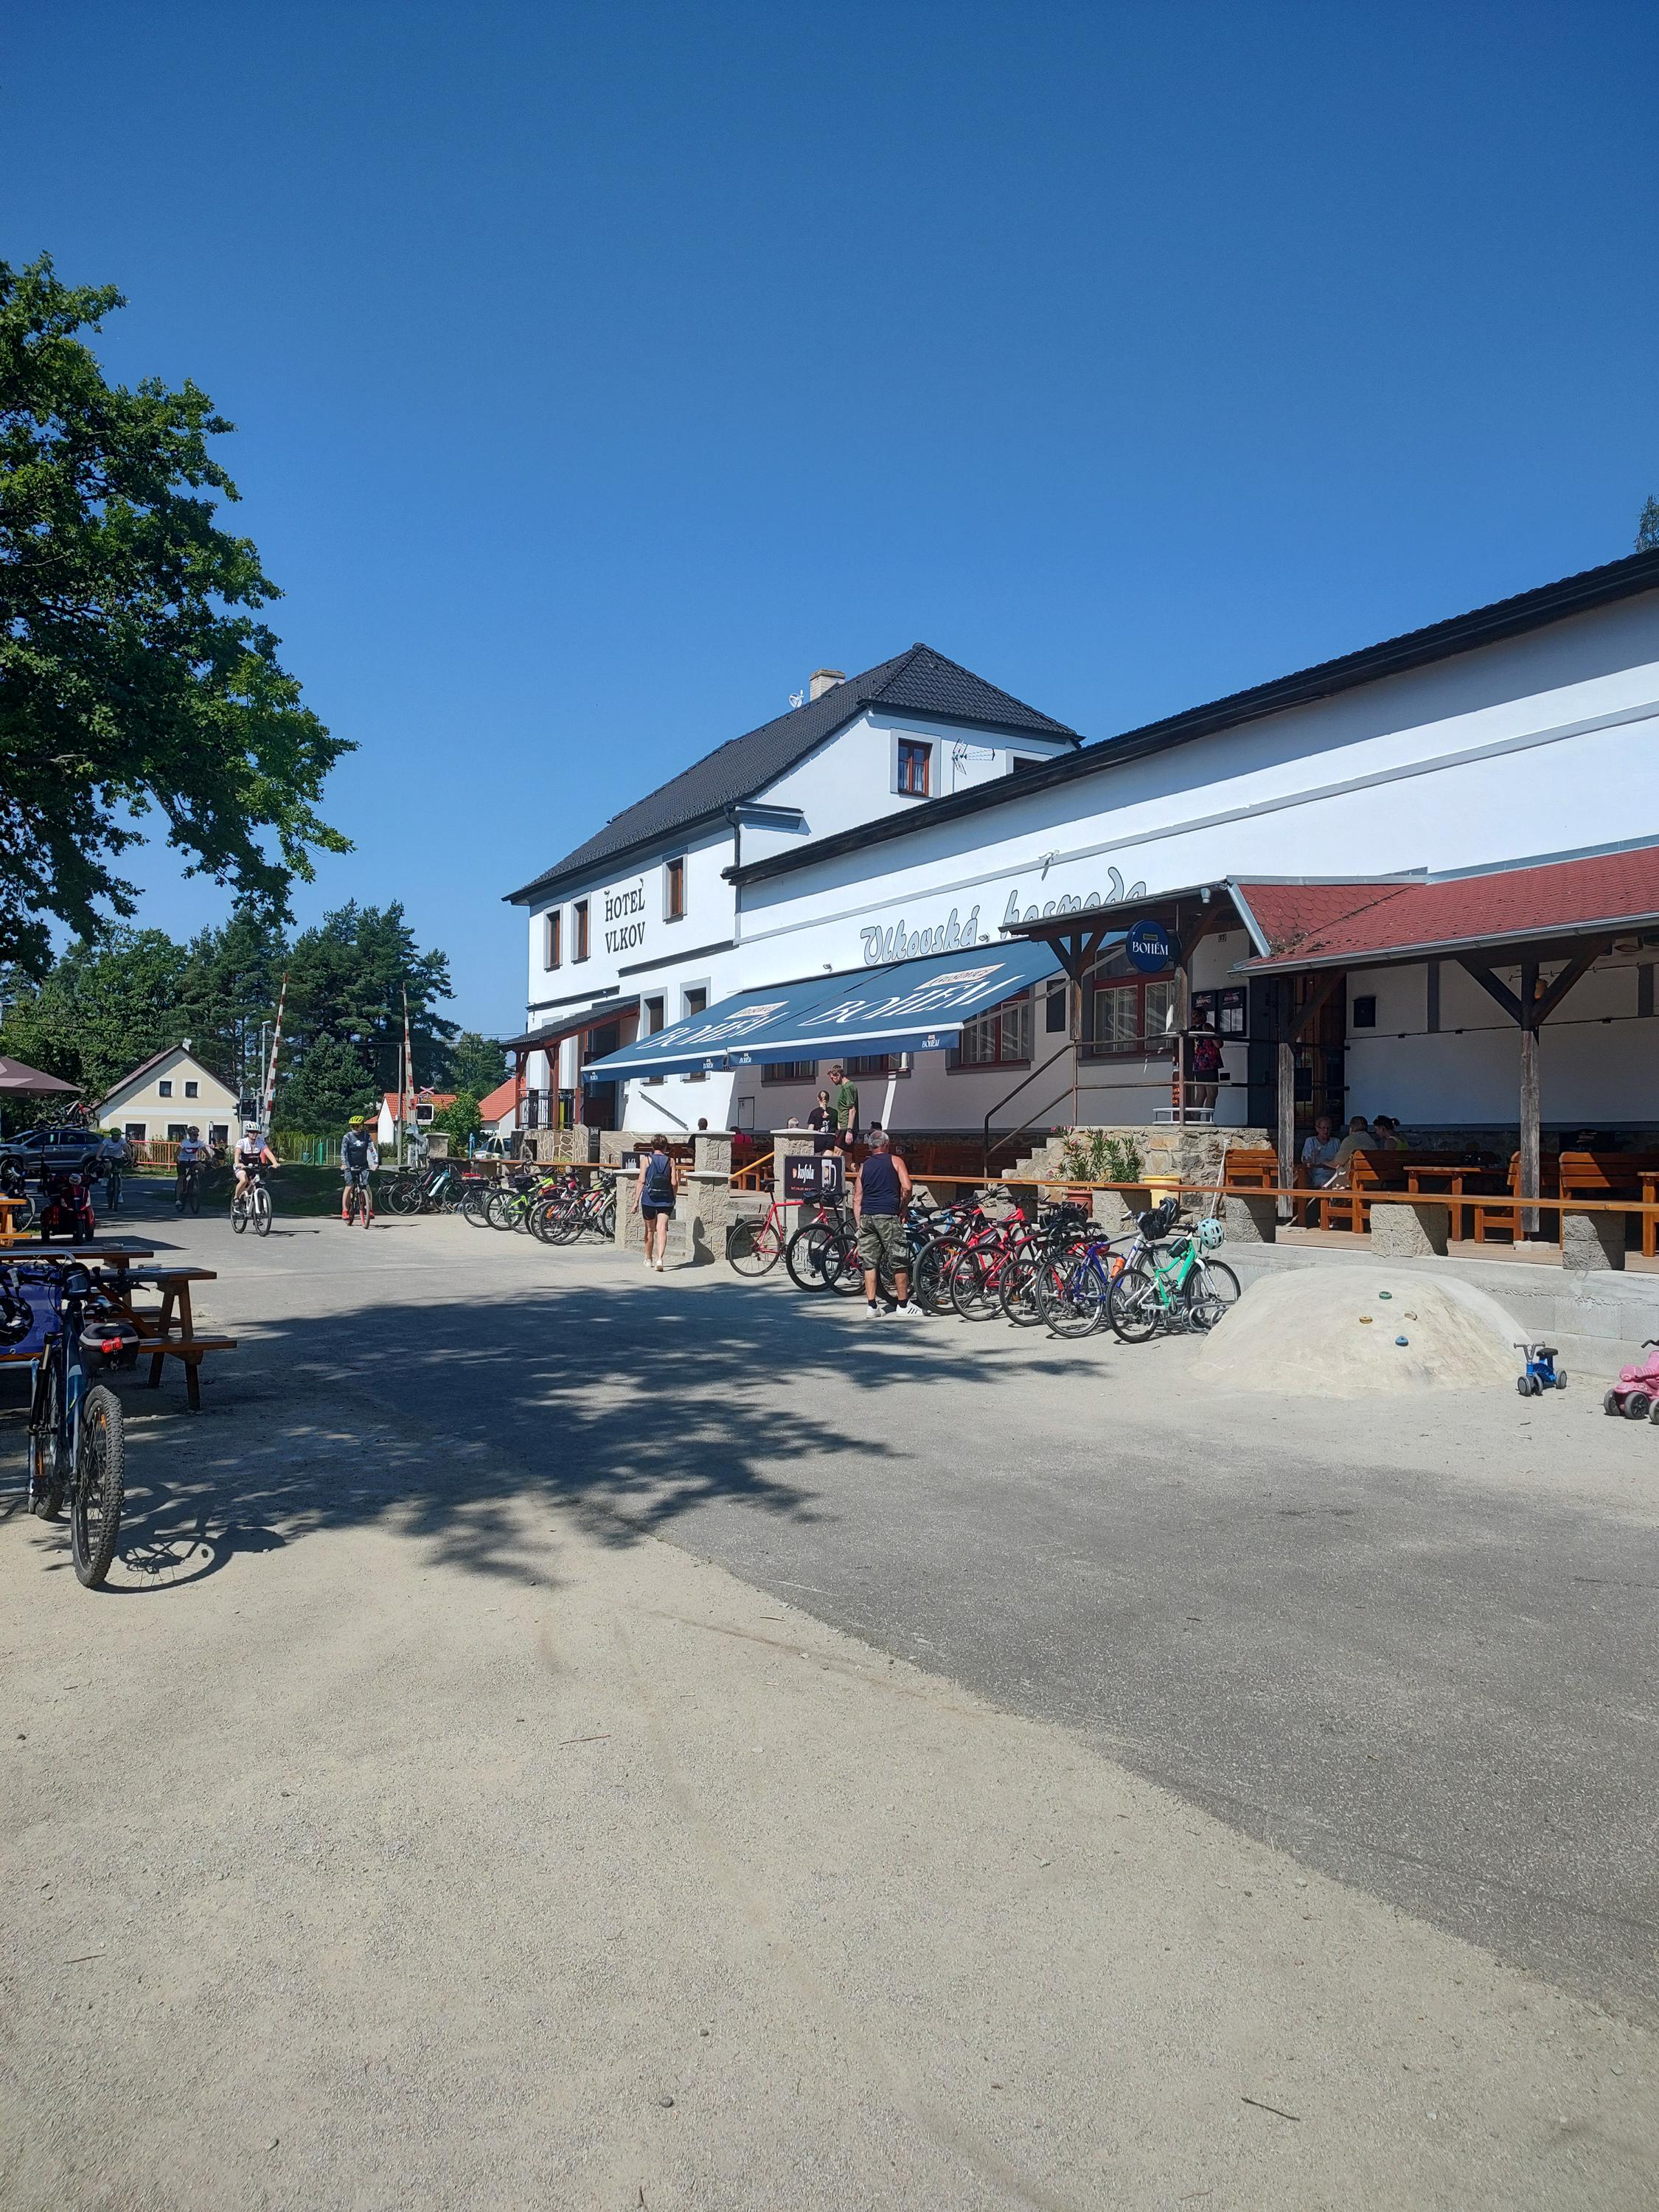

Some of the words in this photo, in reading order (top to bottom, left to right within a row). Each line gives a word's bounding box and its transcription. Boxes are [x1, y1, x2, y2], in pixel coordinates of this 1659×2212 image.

[605, 888, 645, 922] HOTEL
[605, 922, 645, 953] VLKOV
[860, 905, 981, 965] Vlkovská
[1133, 942, 1168, 956] BOHÉM
[796, 974, 1026, 1026] BOHÉM
[797, 1164, 815, 1183] kofola
